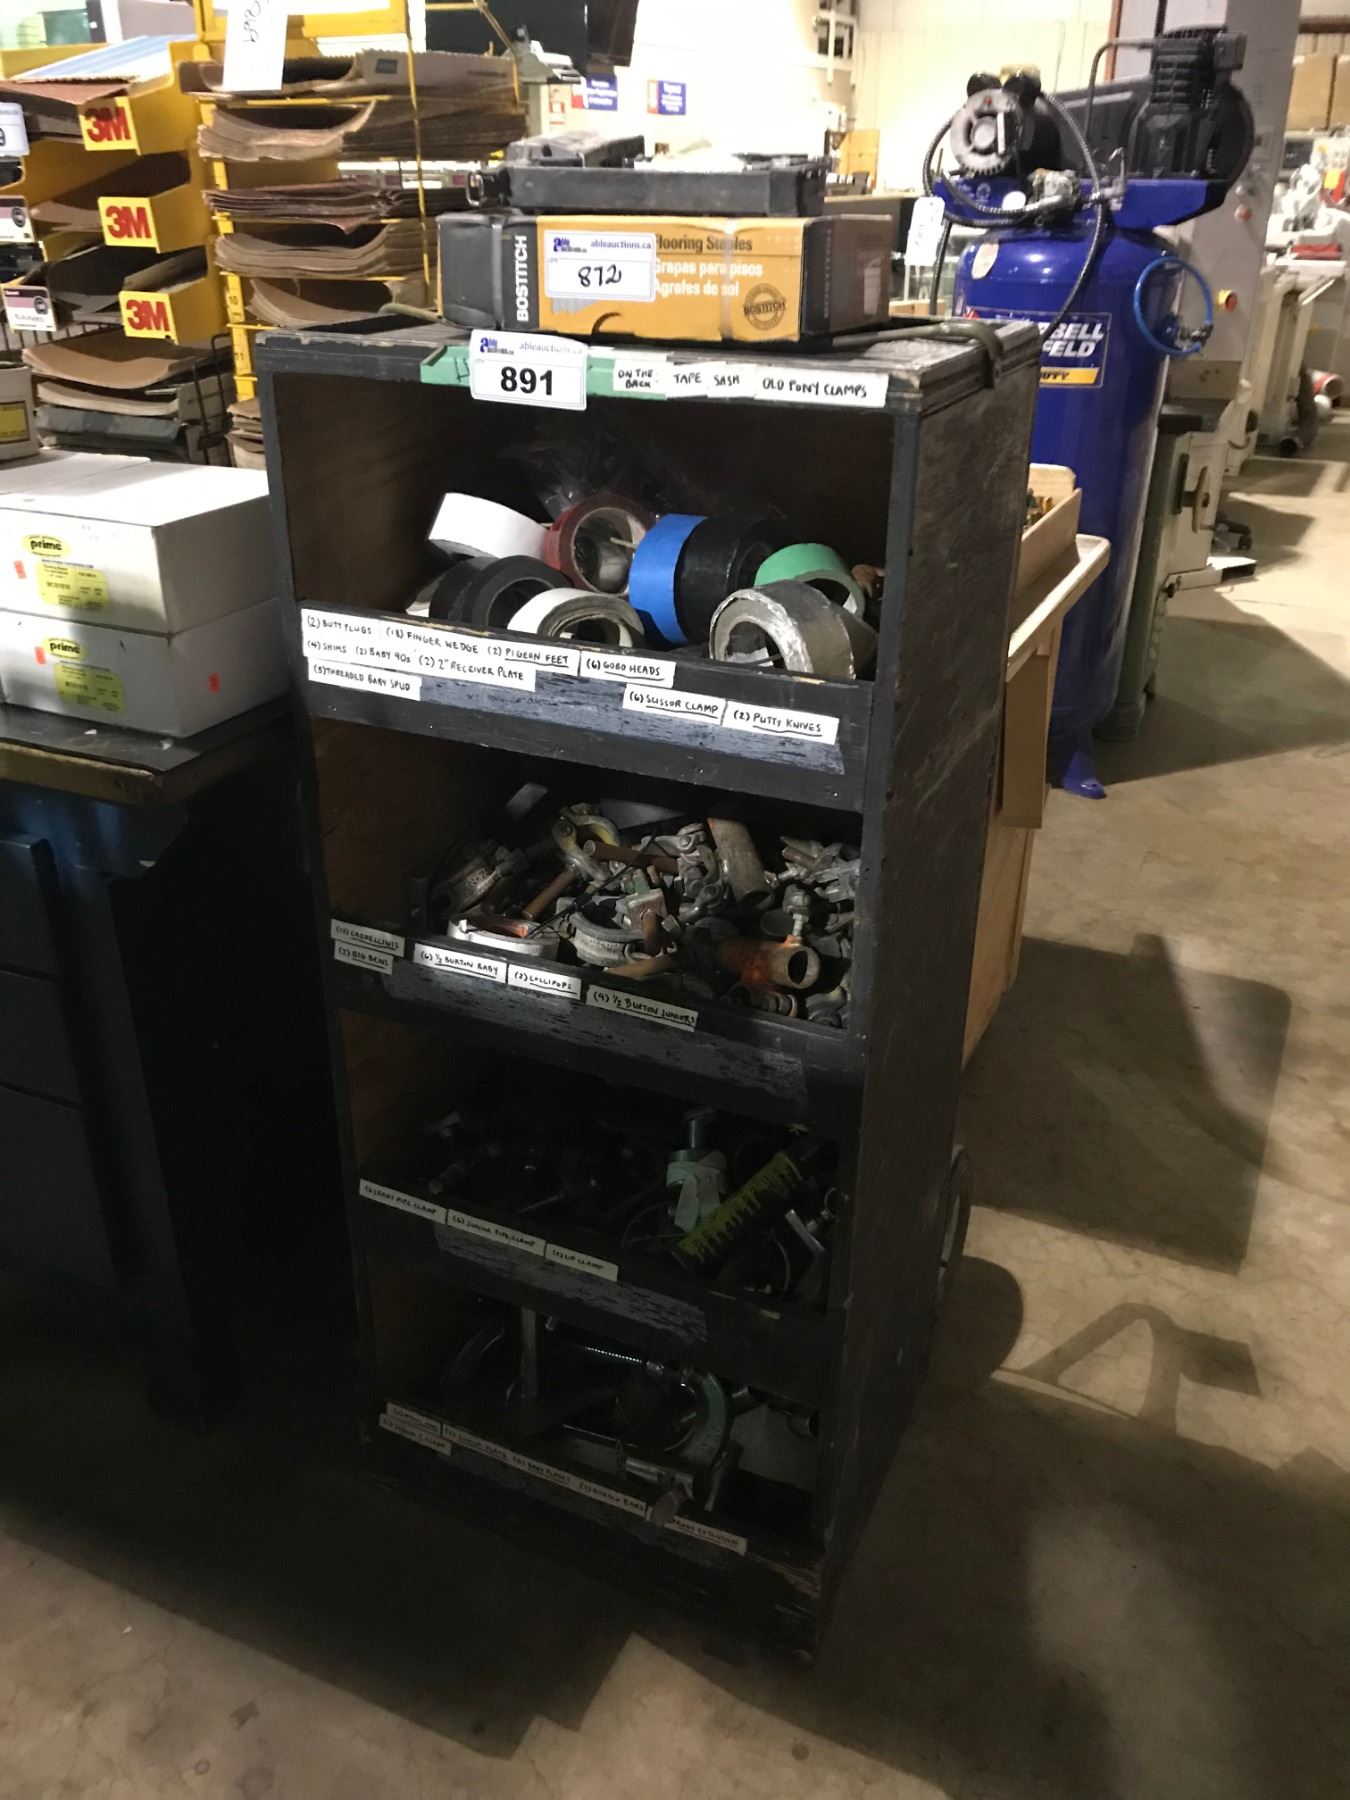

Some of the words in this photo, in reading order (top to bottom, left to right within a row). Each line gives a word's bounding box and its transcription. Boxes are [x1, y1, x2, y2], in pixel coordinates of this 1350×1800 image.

[85, 106, 132, 142] 3M
[105, 205, 152, 238] 3M
[590, 238, 652, 250] ableauctions.ca
[514, 235, 529, 322] BOSTITCH
[578, 264, 622, 288] 872
[700, 262, 727, 278] para
[730, 260, 763, 280] pisos
[703, 280, 718, 296] de
[126, 299, 171, 332] 3M
[500, 366, 553, 396] 891
[618, 370, 632, 379] ON
[635, 368, 653, 378] THE
[673, 372, 702, 384] TAPE
[713, 374, 740, 386] SASH
[625, 380, 651, 389] BACK
[762, 377, 785, 392] OLD
[824, 384, 868, 398] CLAMPS
[30, 539, 62, 551] prime
[307, 615, 321, 628] (2)
[322, 619, 342, 630] BUTT
[344, 624, 372, 635] PLUGS
[50, 642, 80, 654] prime
[407, 632, 442, 647] FINGER
[445, 640, 479, 654] WEDGE
[307, 640, 321, 650] (4)
[323, 643, 347, 654] SHIMS
[355, 646, 368, 656] (2)
[369, 647, 391, 660] BABY
[394, 651, 411, 664] 90s
[418, 655, 435, 668] (2)
[450, 661, 494, 676] RECEIVER
[497, 666, 524, 681] PLATE
[488, 645, 502, 657] (2)
[506, 648, 541, 661] PIGEON
[545, 654, 569, 665] FEET
[586, 658, 601, 670] (6)
[603, 660, 627, 672] GOBO
[629, 664, 661, 677] HEADS
[368, 674, 387, 688] BABY
[390, 680, 411, 692] SPUD
[630, 691, 644, 703] (6)
[646, 694, 682, 708] SCISSOR
[685, 702, 719, 714] CLAMP
[734, 710, 750, 722] (2)
[752, 713, 782, 727] PUTTY
[786, 719, 822, 732] KNIVES
[420, 950, 433, 961] (6)
[444, 956, 474, 968] BURTON
[477, 962, 499, 975] BABY
[514, 971, 528, 982] (2)
[529, 974, 572, 990] LOLLIPOPS
[624, 998, 659, 1015] BURTON
